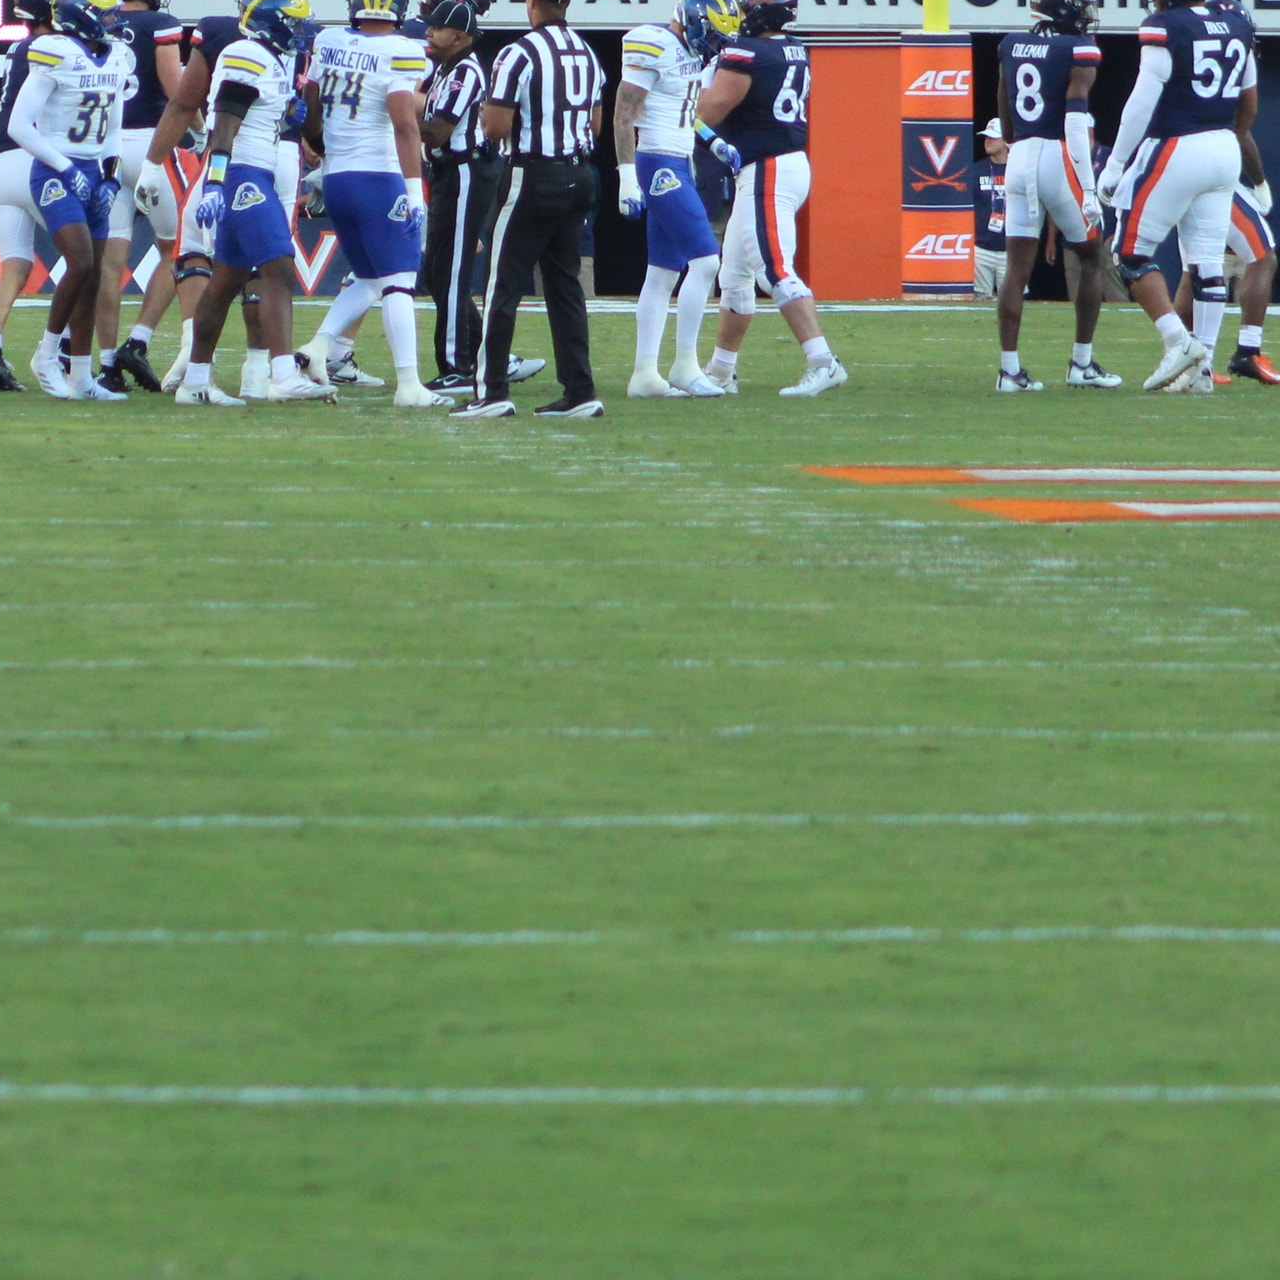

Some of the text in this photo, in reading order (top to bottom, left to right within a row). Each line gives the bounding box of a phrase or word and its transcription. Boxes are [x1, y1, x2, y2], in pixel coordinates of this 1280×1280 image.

[319, 45, 380, 73] SINGLETON
[1012, 43, 1049, 59] COLEMAN
[1191, 40, 1247, 98] 52
[322, 68, 365, 120] 44
[560, 55, 589, 106] U
[909, 70, 971, 91] ACC
[1016, 64, 1045, 121] 8
[910, 234, 972, 254] ACC
